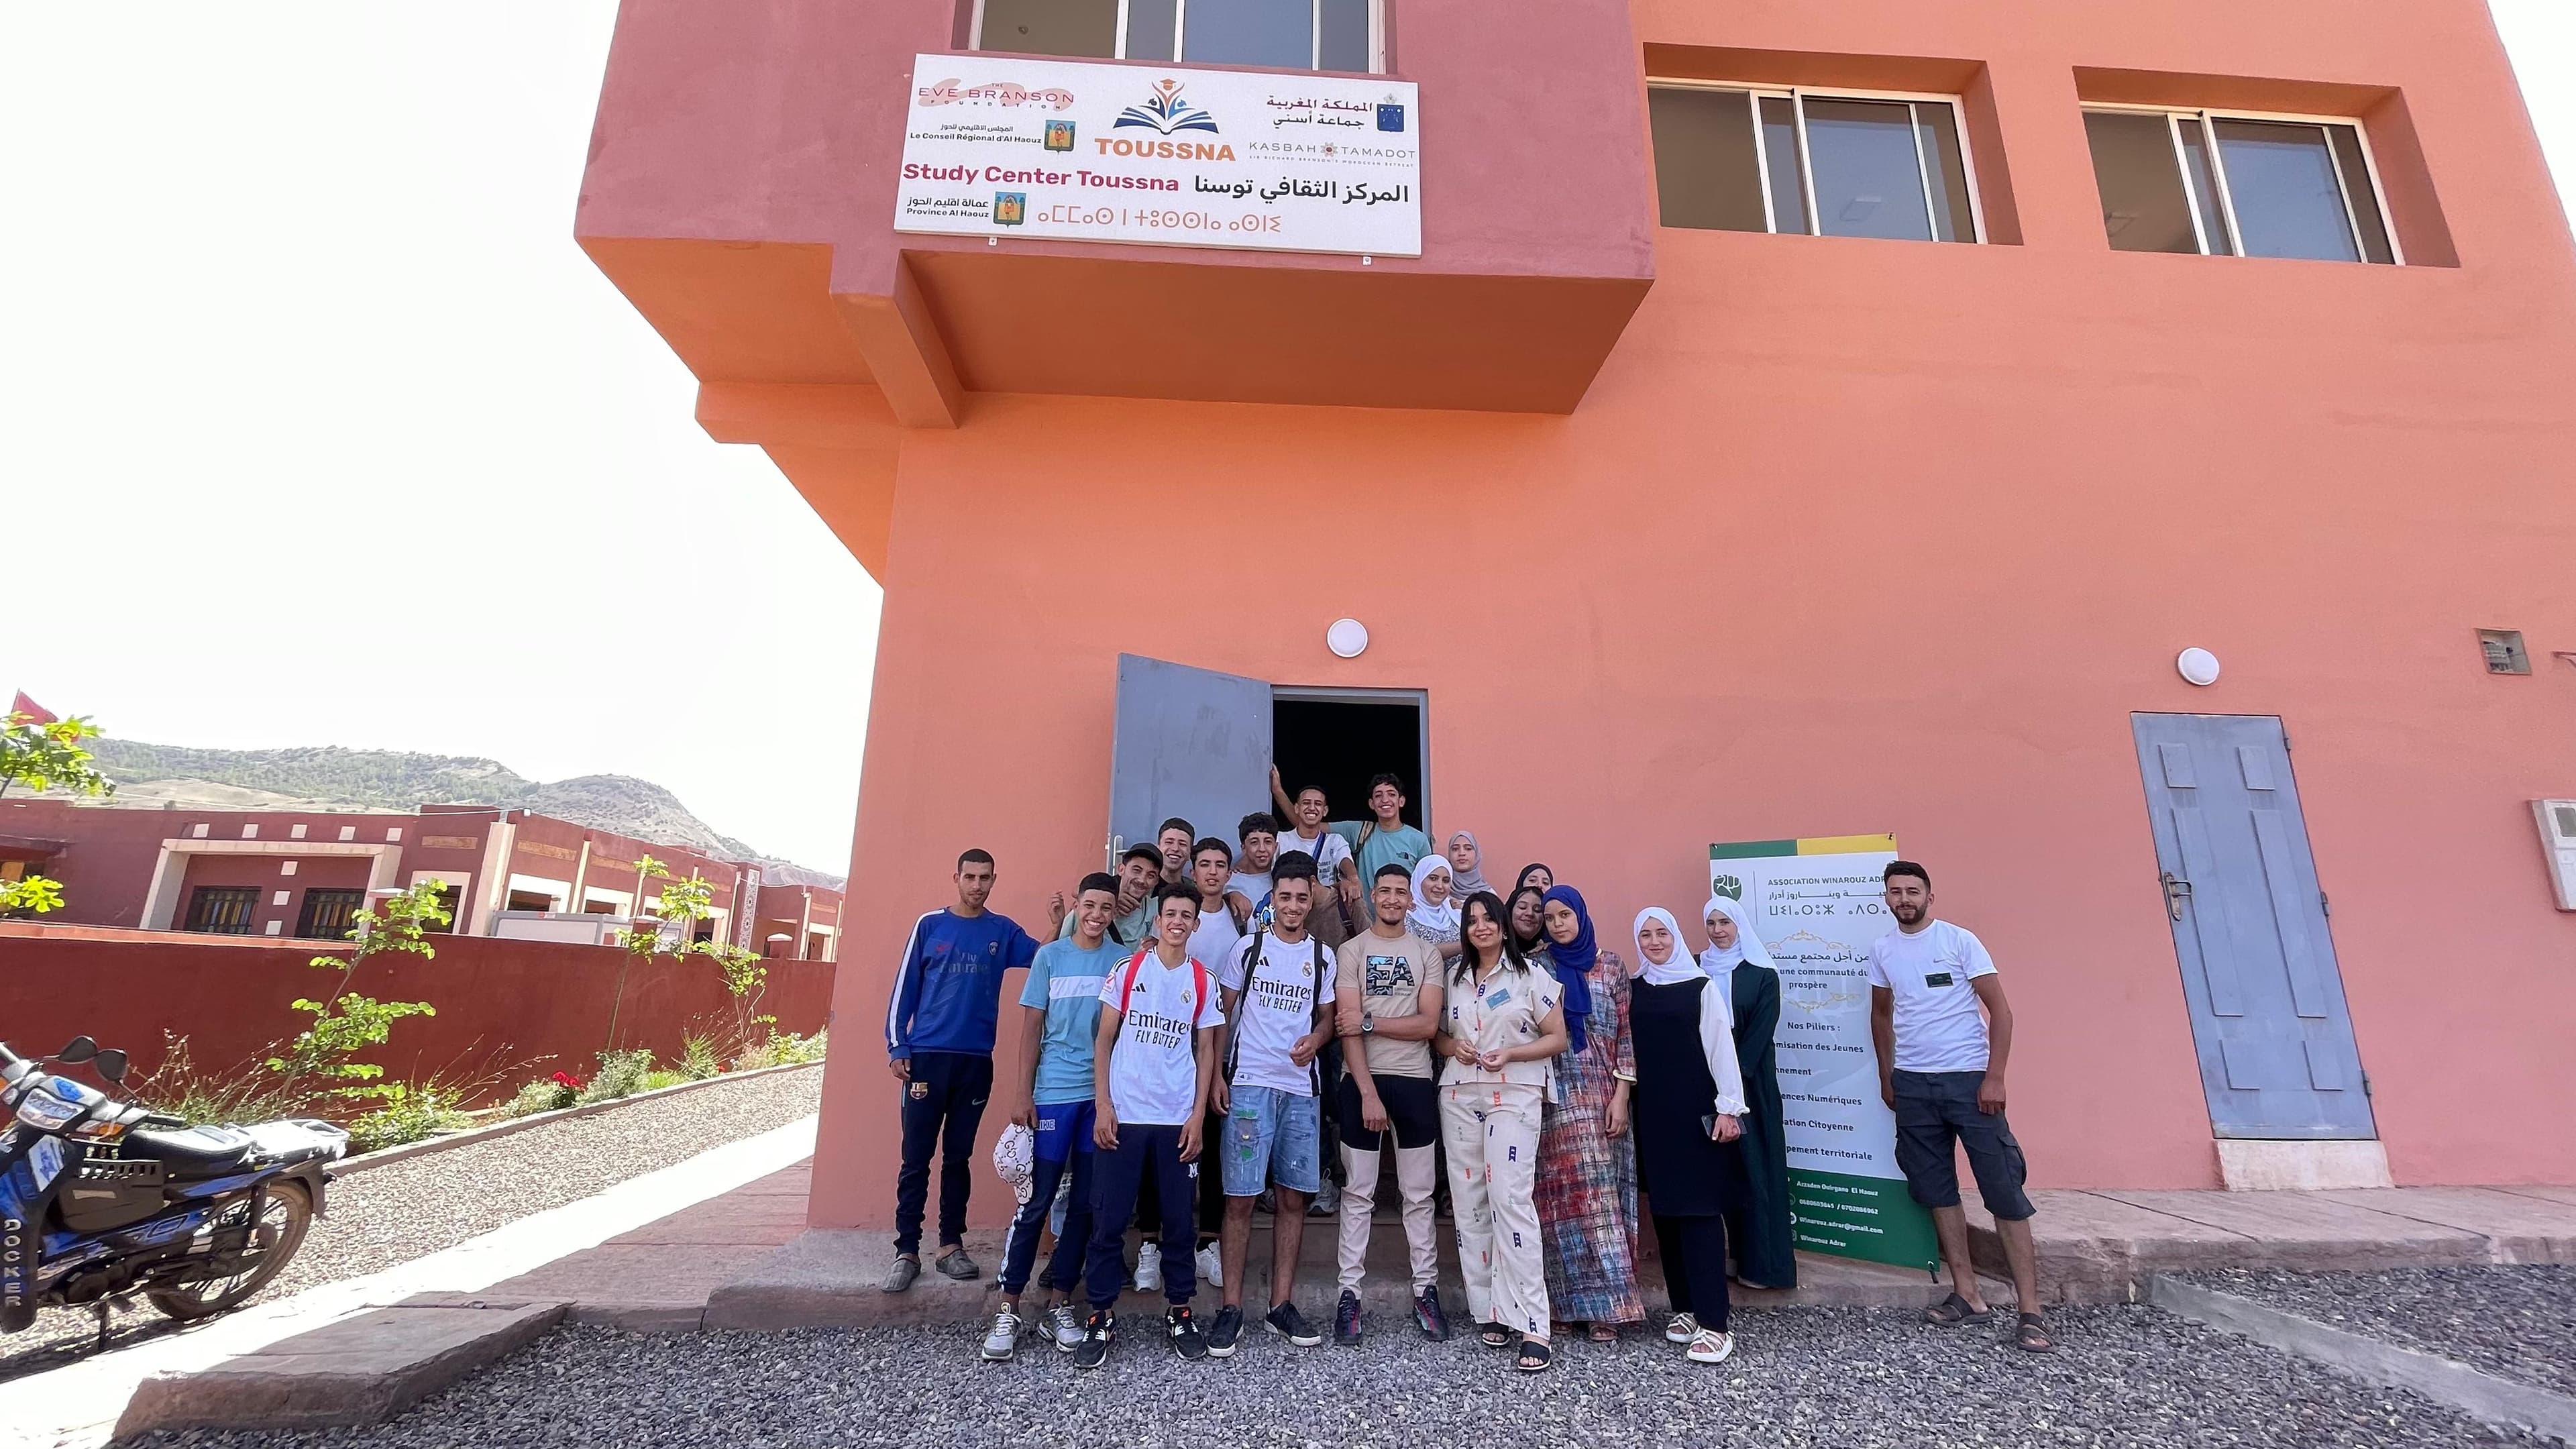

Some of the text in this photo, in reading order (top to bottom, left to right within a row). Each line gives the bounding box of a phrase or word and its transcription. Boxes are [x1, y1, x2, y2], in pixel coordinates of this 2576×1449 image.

[918, 88, 1073, 103] EVE BRANSON
[930, 100, 1061, 109] FOUNDATION
[1267, 95, 1373, 112] المملكة المغربية
[1273, 111, 1364, 129] جماعة أسني
[957, 133, 996, 142] Régional
[1095, 138, 1236, 161] TOUSSNA
[1249, 142, 1415, 158] KASBAH TAMADOT
[903, 164, 1179, 191] Study Center Toussna
[1195, 175, 1409, 205] المركز الثقافي توسنا
[907, 197, 932, 207] الحوز
[961, 199, 989, 208] عمالة
[906, 208, 947, 216] Province
[961, 210, 989, 218] Haouz
[1768, 877, 1820, 885] ASSOCIATION
[1821, 876, 1866, 884] WINAROUZ
[1848, 904, 1887, 915] ⴰⴷⵔⴰ
[1800, 953, 1830, 963] مجتمع
[1833, 950, 1852, 963] أجل
[1366, 955, 1415, 996] EA
[1797, 968, 1856, 976] communauté
[1252, 976, 1311, 1000] Emirates
[1789, 981, 1828, 990] prospère
[1259, 995, 1303, 1014] FLY BETTER
[1787, 1022, 1804, 1030] Nos
[1807, 1022, 1835, 1031] Piliers
[1135, 1030, 1151, 1044] FLY
[1776, 1041, 1813, 1050] misation
[1833, 1044, 1864, 1053] Jeunes
[1807, 1093, 1862, 1106] Numériques
[1038, 1119, 1056, 1131] IKE
[1784, 1119, 1854, 1131] ation Citoyenne
[1786, 1146, 1872, 1161] pement territoriale
[3, 1218, 22, 1307] DOCKER
